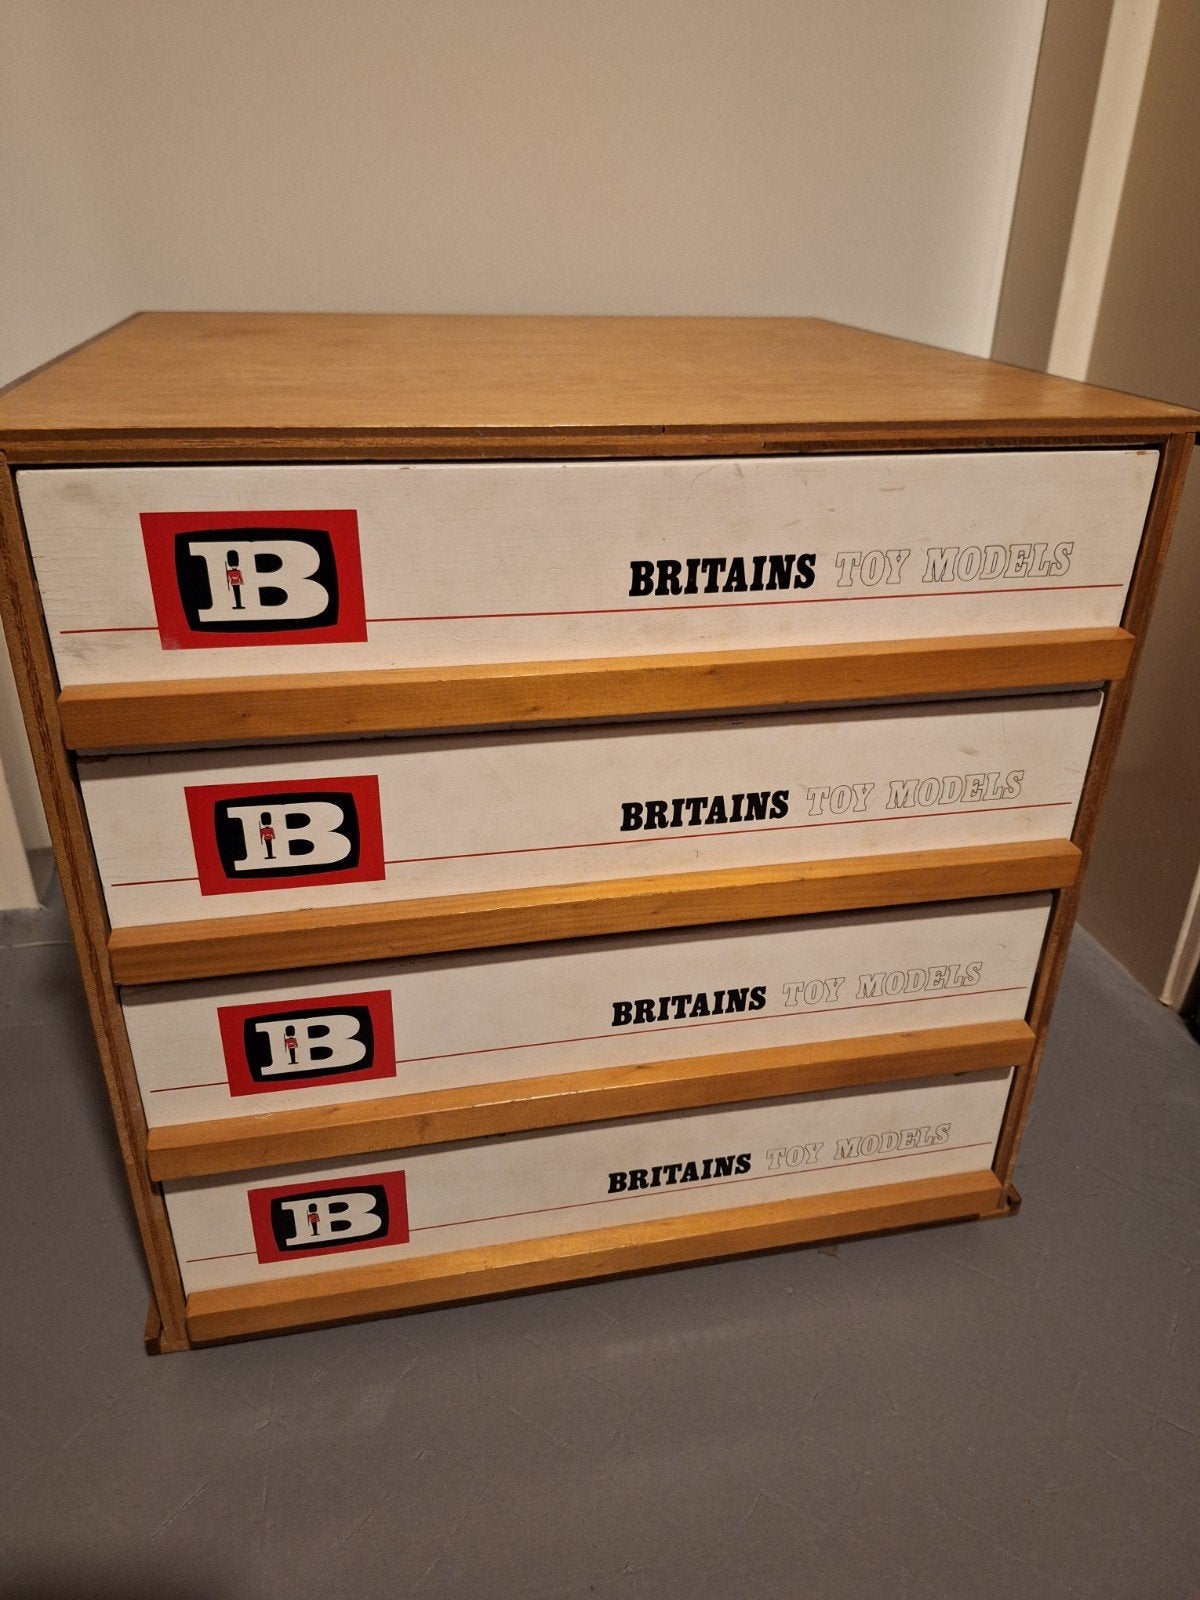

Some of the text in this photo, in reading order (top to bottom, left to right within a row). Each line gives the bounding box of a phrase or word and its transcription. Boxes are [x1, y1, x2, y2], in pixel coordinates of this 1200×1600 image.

[189, 540, 329, 622] B
[629, 541, 1075, 597] BRITAINS TOY MODELS
[620, 770, 1024, 832] BRITAINS TOY MODELS
[227, 801, 351, 871] B
[611, 961, 983, 1027] BRITAINS TOY MODELS
[255, 1014, 366, 1075] B
[608, 1122, 952, 1194] BRITAINS TOY MODELS
[281, 1192, 382, 1246] B
